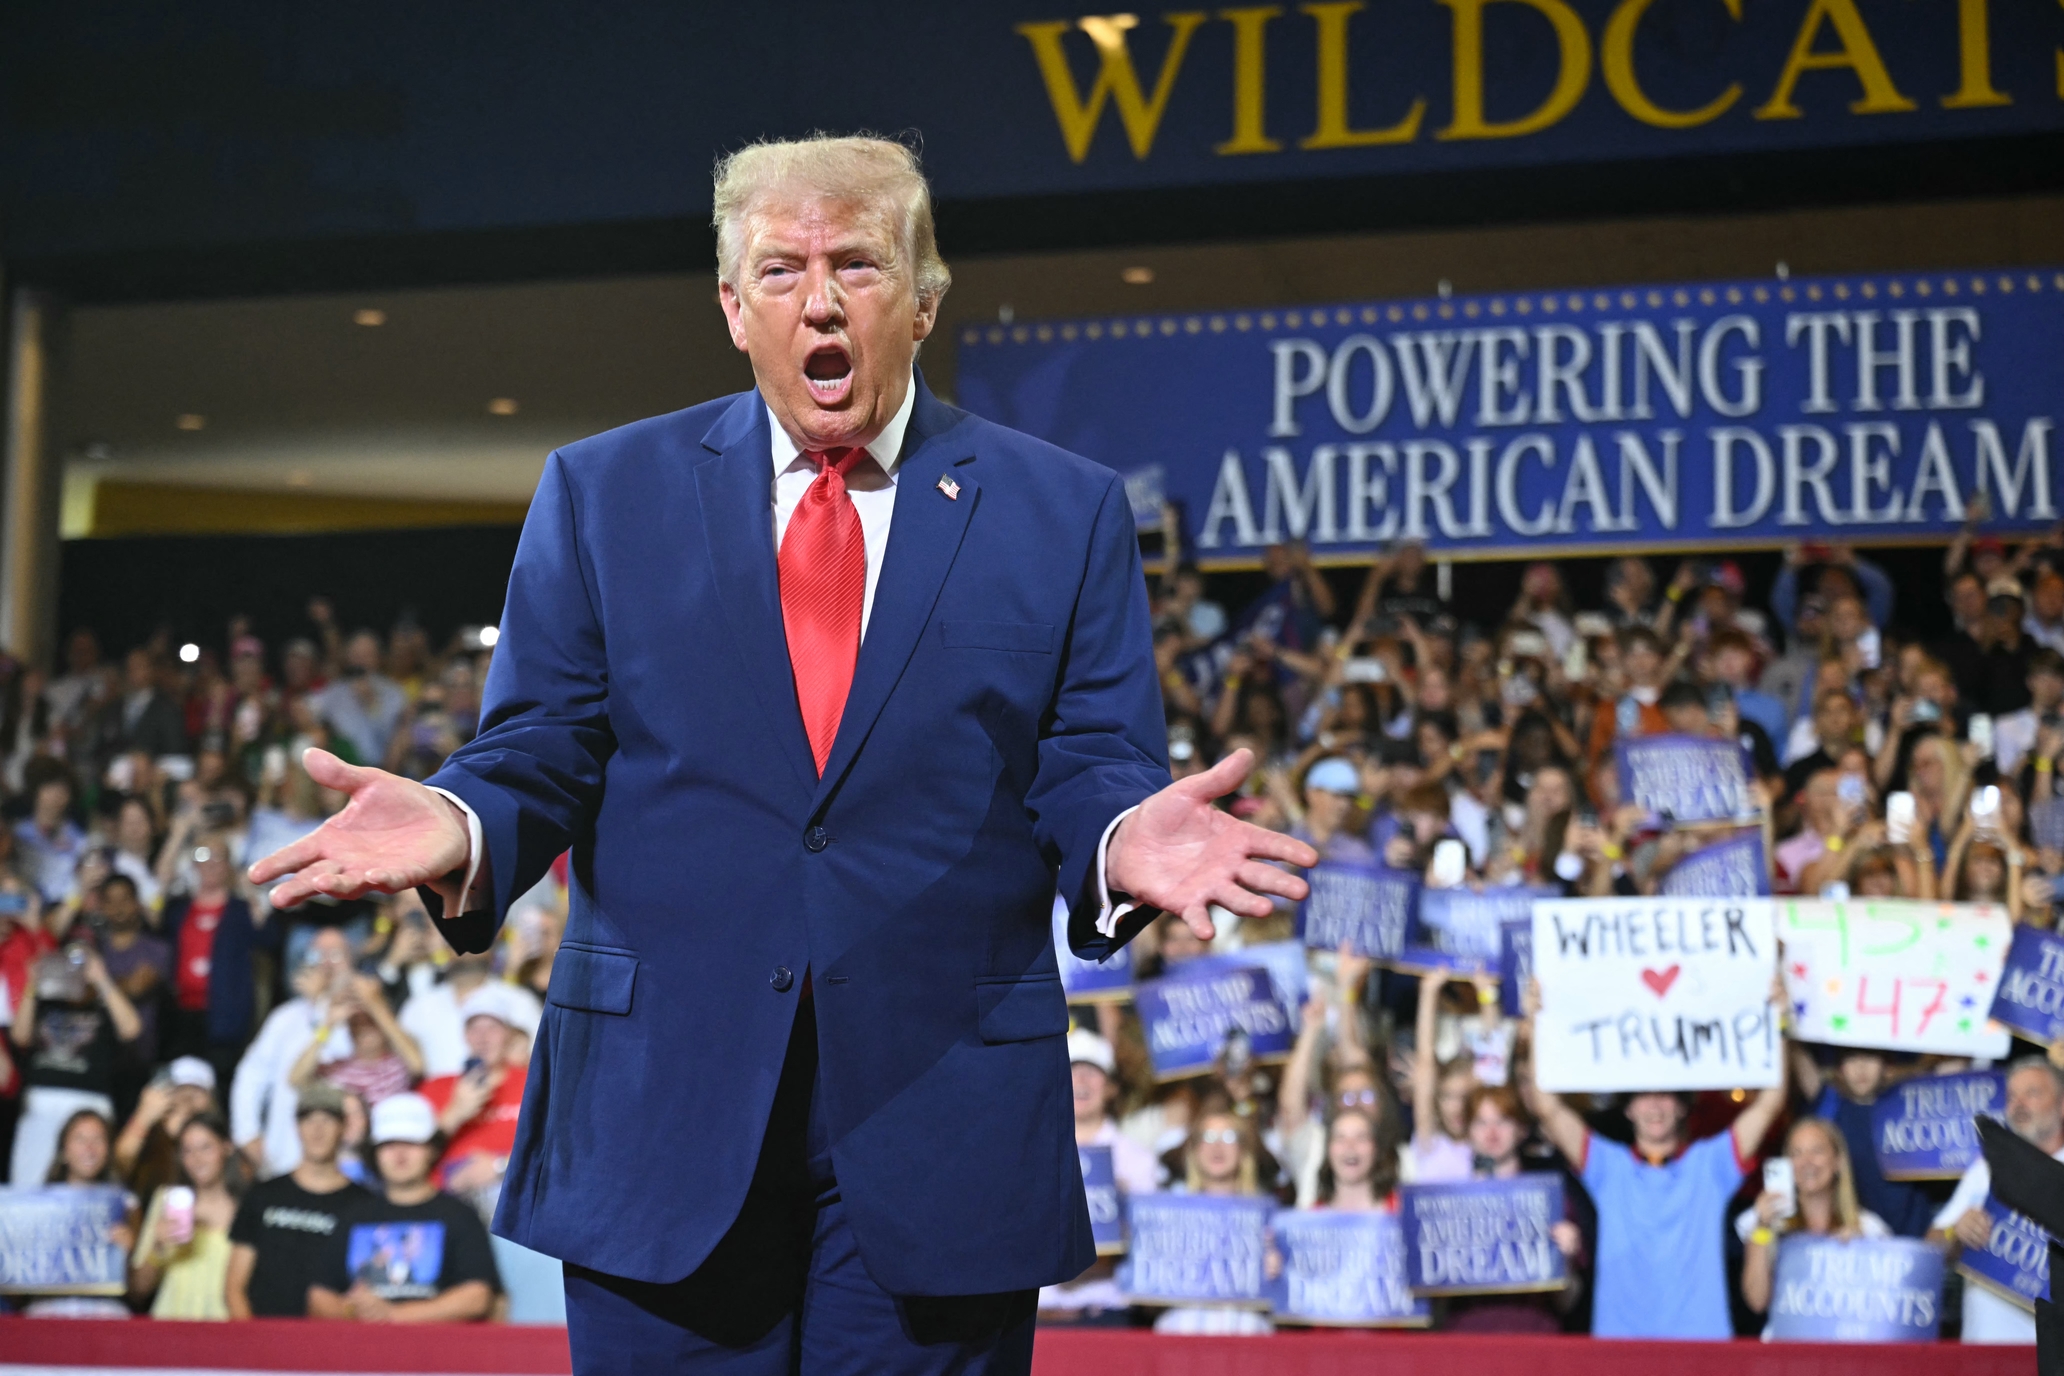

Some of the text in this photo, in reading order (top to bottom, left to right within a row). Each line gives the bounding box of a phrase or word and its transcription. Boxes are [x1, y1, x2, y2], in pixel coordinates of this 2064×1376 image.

[1015, 0, 2064, 163] WILDCAT
[1267, 305, 1984, 437] POWERING THE
[1197, 428, 1685, 548] AMERICAN
[1706, 416, 2061, 529] DREAM
[1552, 907, 1757, 957] WHEELER
[1159, 972, 1255, 1018] TRUMP
[1856, 976, 1948, 1038] 47
[1571, 999, 1773, 1070] TRUMP!
[1902, 1077, 1997, 1119] TRUMP
[1417, 1215, 1550, 1248] AMERICAN
[1133, 1252, 1261, 1297] DREAM
[1420, 1241, 1552, 1285] DREAM
[1806, 1245, 1915, 1288] TRUMP
[1778, 1279, 1935, 1328] ACCOUNTS
